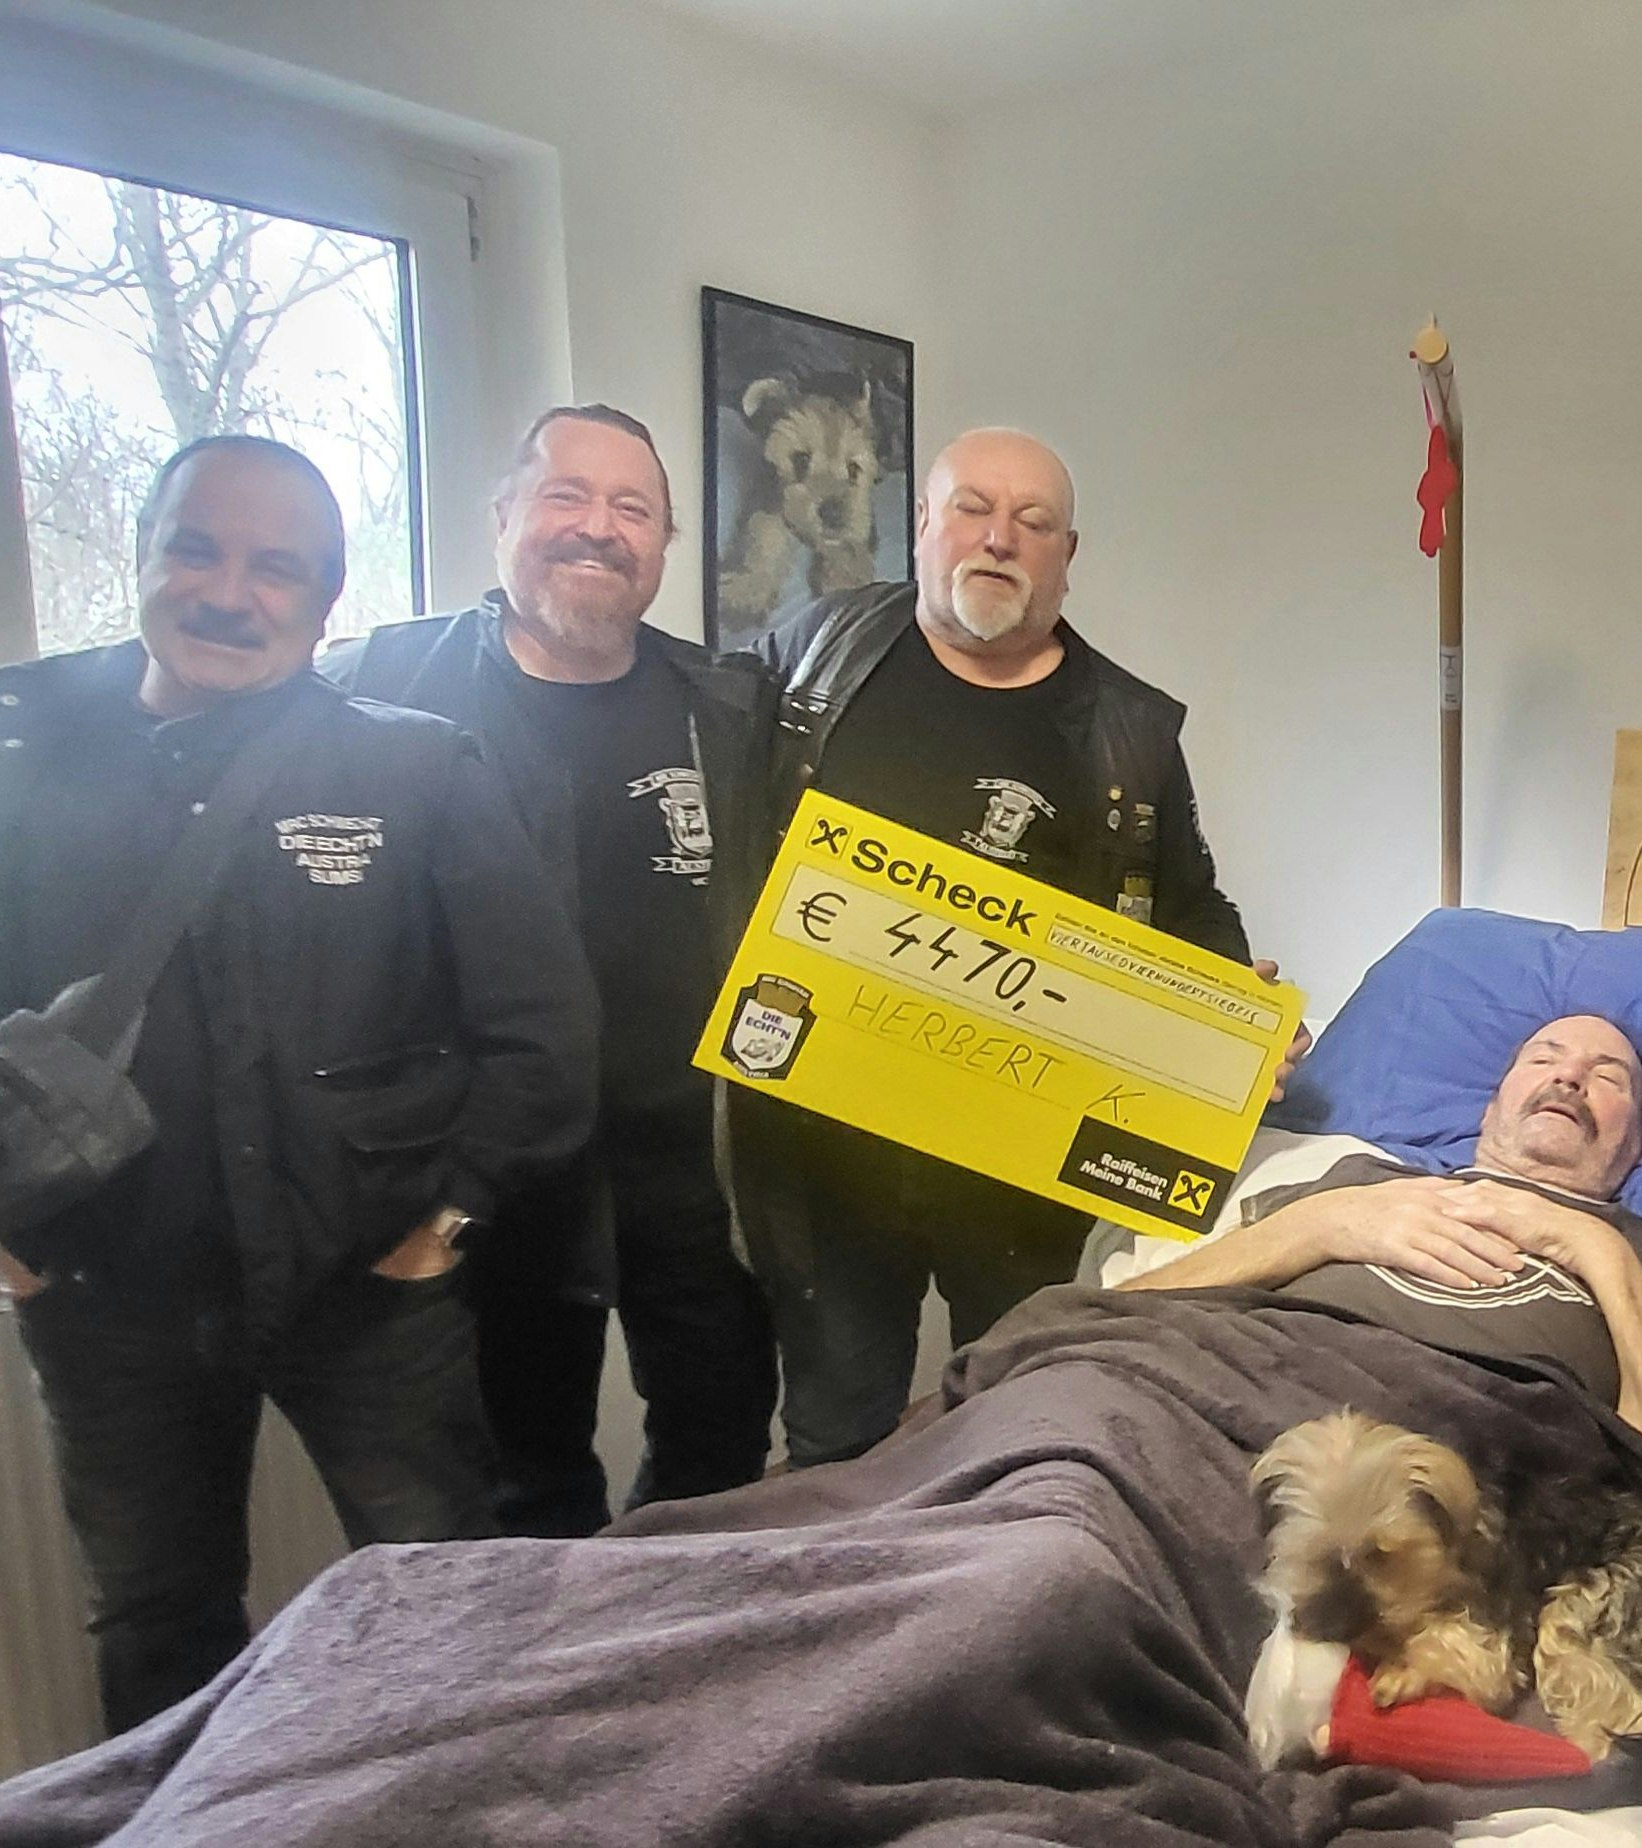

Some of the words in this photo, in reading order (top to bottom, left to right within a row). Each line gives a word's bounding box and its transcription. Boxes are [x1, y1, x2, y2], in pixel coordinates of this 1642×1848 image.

[851, 838, 1039, 938] Scheck
[796, 891, 847, 943] €
[884, 912, 1068, 1012] 4470,-
[761, 1010, 784, 1025] DIE
[847, 984, 1068, 1089] HERBERT
[1086, 1084, 1146, 1125] K.
[1079, 1160, 1125, 1187] Meine
[1125, 1176, 1164, 1201] Bank
[1101, 1152, 1169, 1189] Raiffeisen
